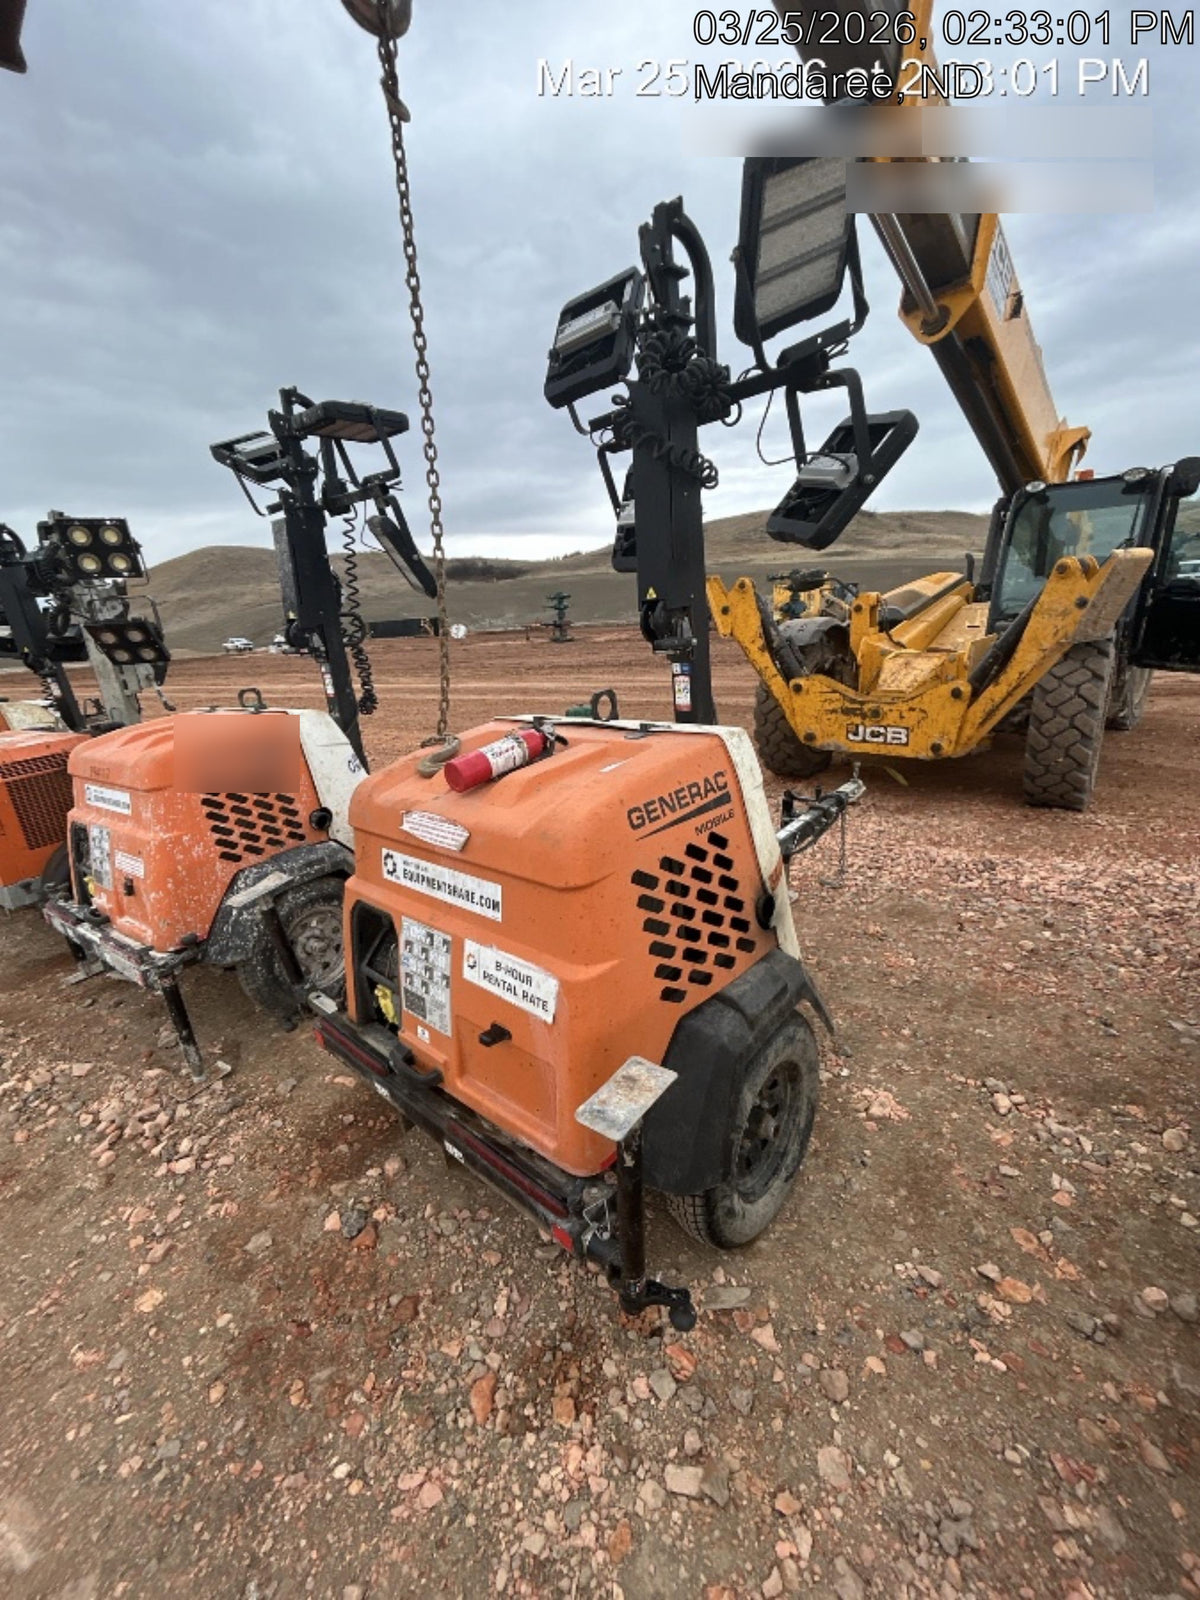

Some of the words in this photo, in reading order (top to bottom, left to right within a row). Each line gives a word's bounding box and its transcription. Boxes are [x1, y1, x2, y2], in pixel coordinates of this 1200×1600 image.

[847, 724, 908, 744] JCB
[627, 770, 729, 831] GENERAC
[694, 808, 735, 836] MOBILE
[402, 867, 501, 913] EQUIPMENTSHARE.COM
[483, 969, 518, 997] RENTAL
[522, 989, 549, 1012] RATE
